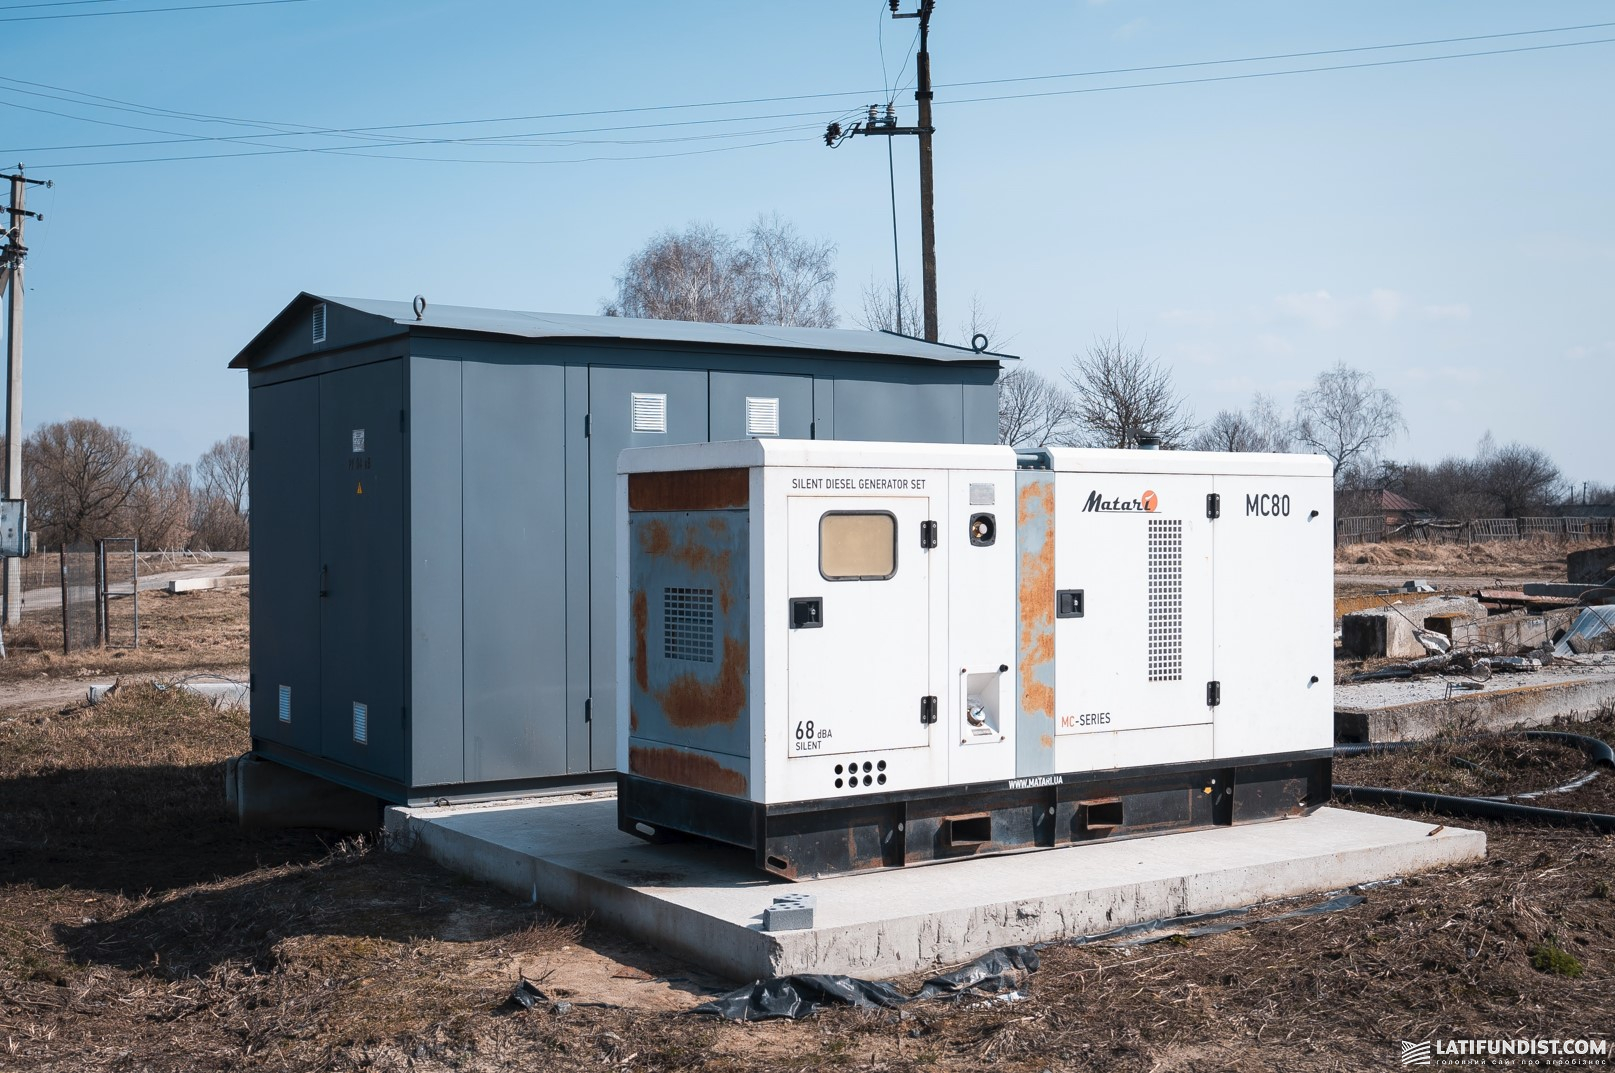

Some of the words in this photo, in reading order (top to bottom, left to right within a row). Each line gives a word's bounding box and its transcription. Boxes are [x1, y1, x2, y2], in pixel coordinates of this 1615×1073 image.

[792, 478, 823, 489] SILENT
[826, 478, 856, 489] DIESEL
[859, 479, 908, 490] GENERATOR
[911, 480, 926, 490] SET
[1082, 490, 1157, 513] Matari
[1246, 493, 1290, 517] MC80
[1061, 712, 1111, 728] MC-SERIES
[795, 720, 815, 740] 68
[817, 729, 833, 739] dBA
[795, 740, 822, 751] SILENT
[1008, 776, 1063, 790] WWW.MATARI.UA
